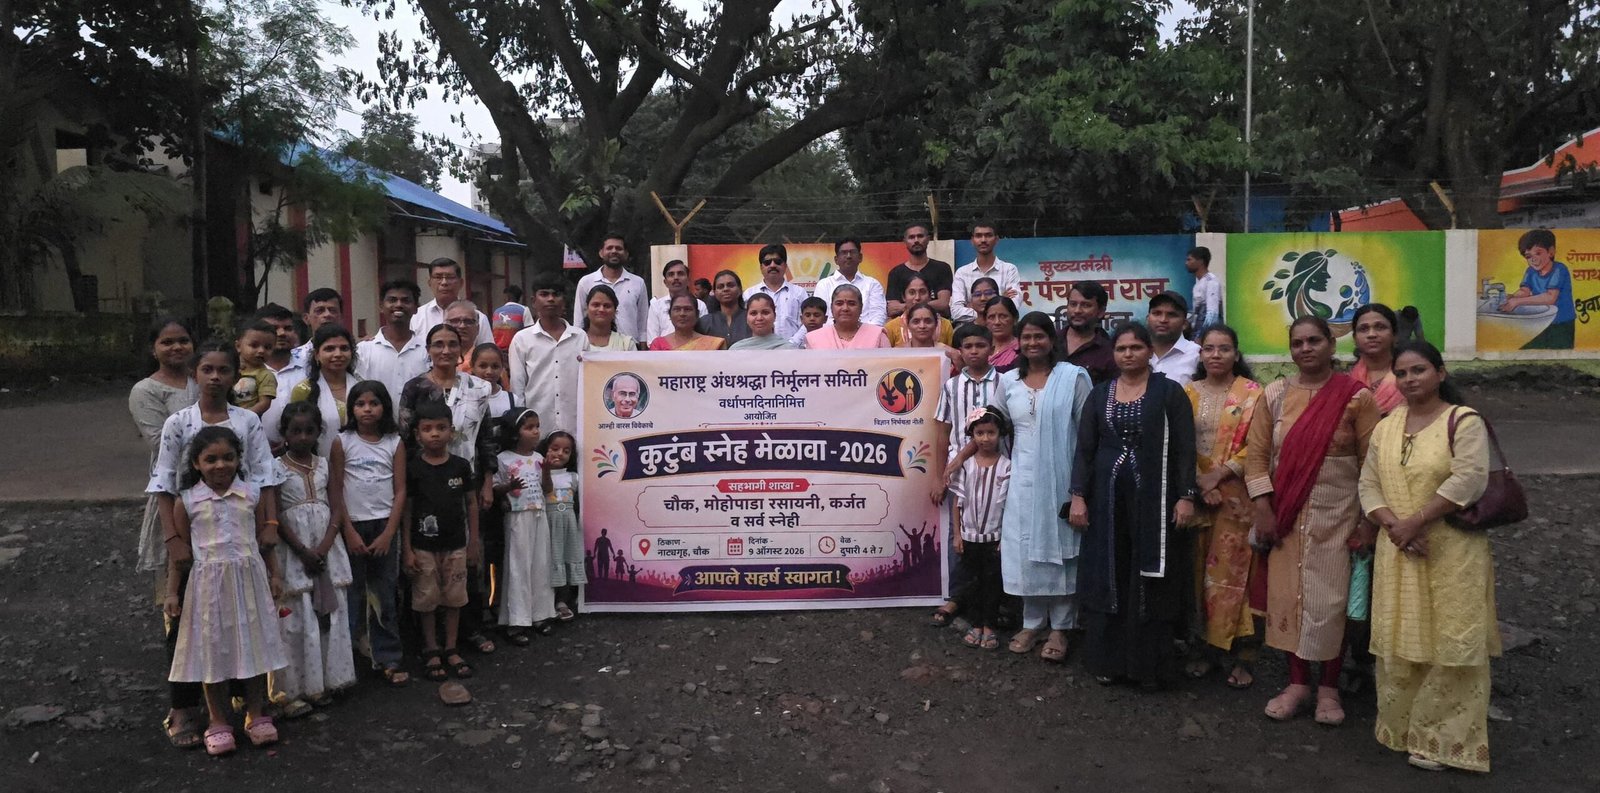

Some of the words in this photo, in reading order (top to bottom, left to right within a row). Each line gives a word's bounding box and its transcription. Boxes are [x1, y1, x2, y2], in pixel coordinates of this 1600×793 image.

[658, 376, 707, 393] महाराष्ट्र
[711, 371, 767, 390] अंधश्रद्धा
[771, 370, 821, 392] निर्मूलन
[824, 369, 868, 388] समिती
[719, 394, 805, 409] वर्धापनदिनानिमित्त
[744, 412, 777, 421] आयोजित
[638, 435, 697, 475] कुटुंब
[702, 433, 748, 464] स्नेह
[753, 432, 827, 462] मेळावा
[728, 481, 766, 491] सहभागी
[768, 482, 794, 490] शाखा
[663, 494, 699, 513] चौक,
[704, 494, 764, 512] मोहोपाडा
[768, 494, 825, 511] रसायनी,
[829, 493, 866, 510] कर्जत
[730, 517, 740, 527] व
[744, 512, 765, 527] सर्व
[768, 512, 800, 528] स्नेही
[657, 537, 681, 546] ठिकाण
[748, 536, 769, 545] दिनांक
[692, 547, 710, 556] चौक
[757, 546, 783, 556] ऑगस्ट
[840, 546, 861, 556] दुपारी
[694, 568, 741, 586] आपले
[743, 568, 781, 586] सहर्ष
[783, 570, 833, 585] स्वागत
